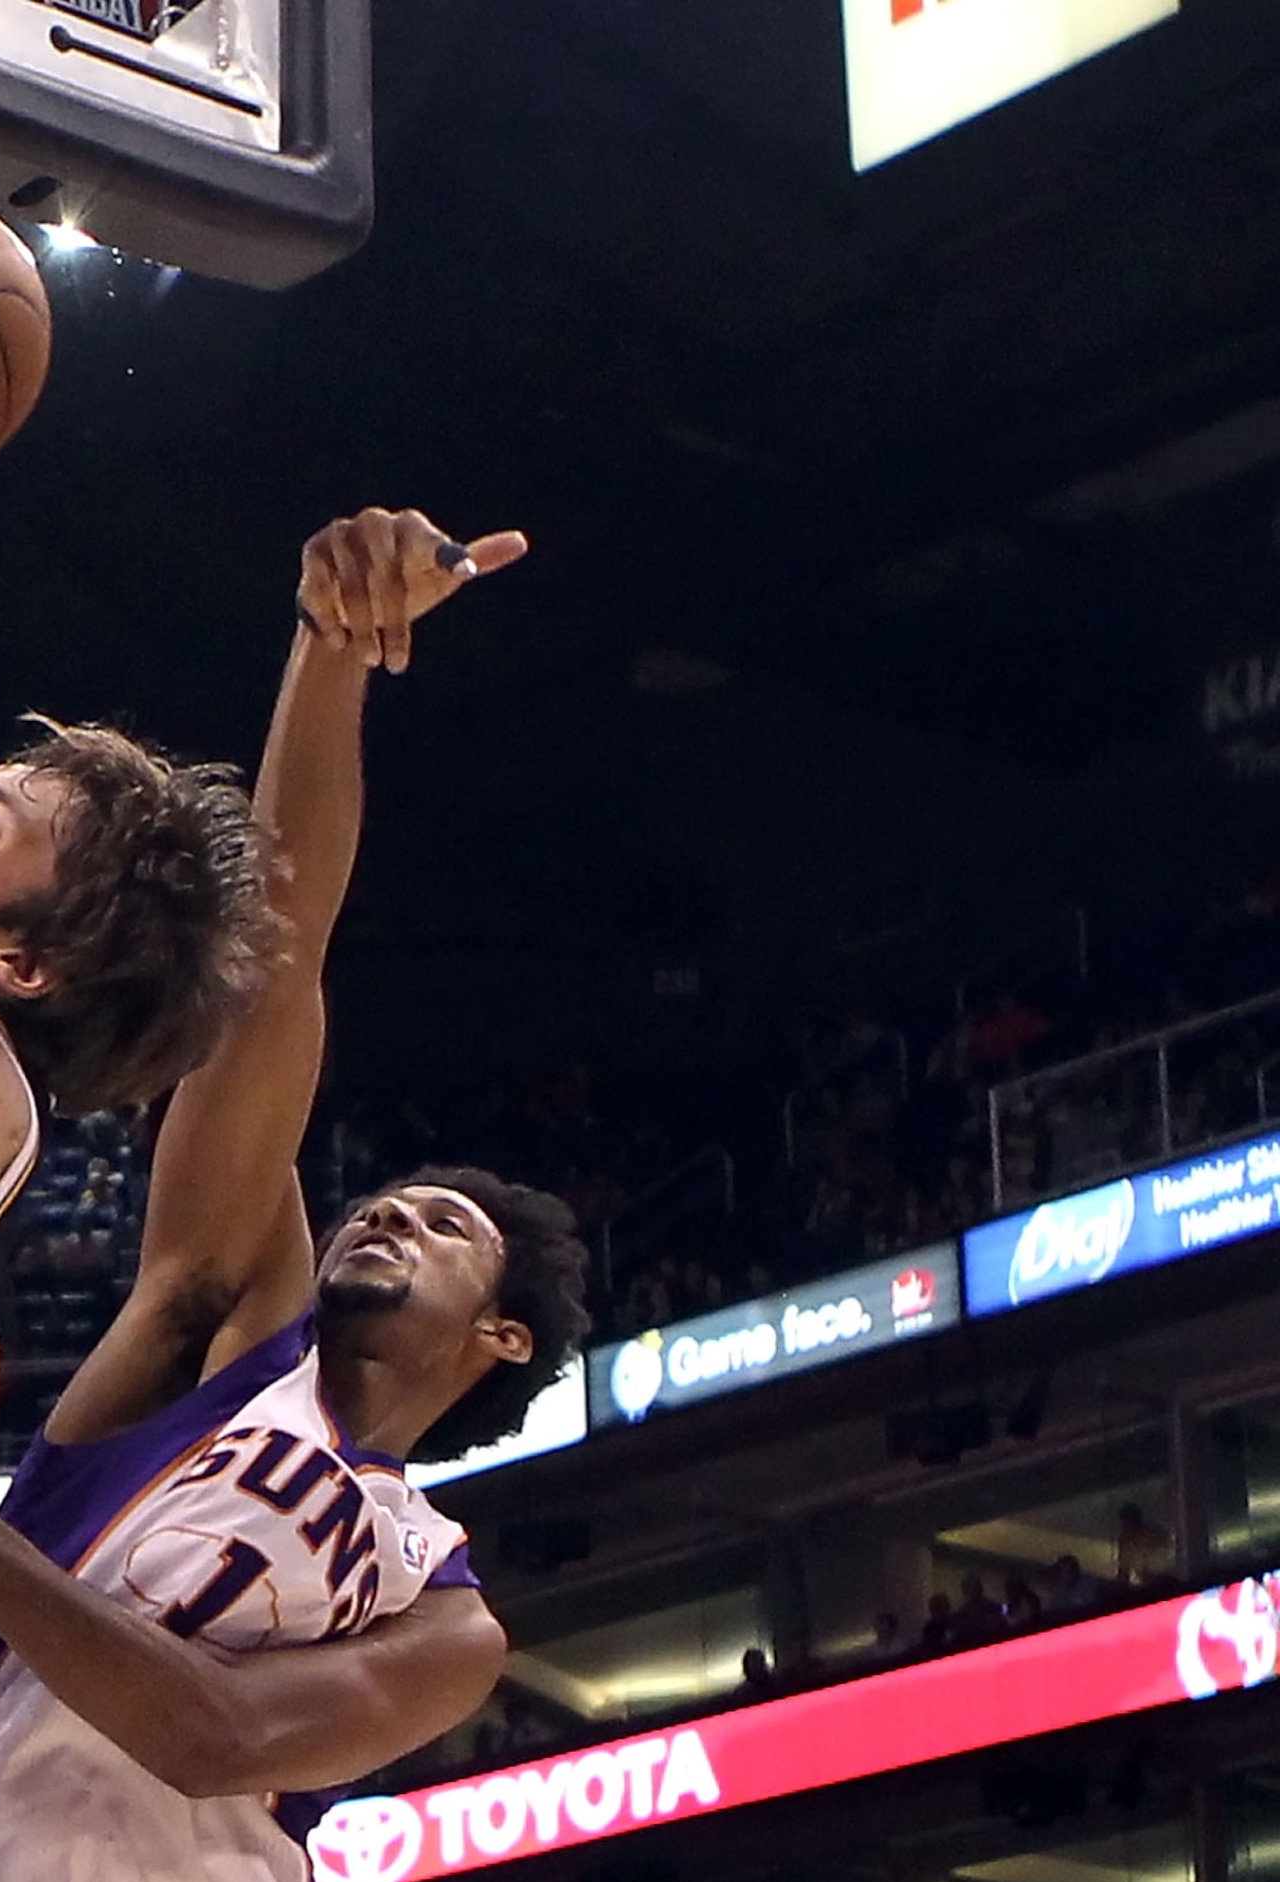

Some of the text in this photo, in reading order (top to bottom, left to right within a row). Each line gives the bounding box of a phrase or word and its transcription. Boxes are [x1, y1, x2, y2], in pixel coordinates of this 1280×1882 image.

[1018, 1201, 1124, 1280] Dial
[667, 1321, 777, 1388] Game
[781, 1296, 873, 1356] face.
[155, 1536, 273, 1641] 1
[427, 1730, 721, 1865] TOYOTA
